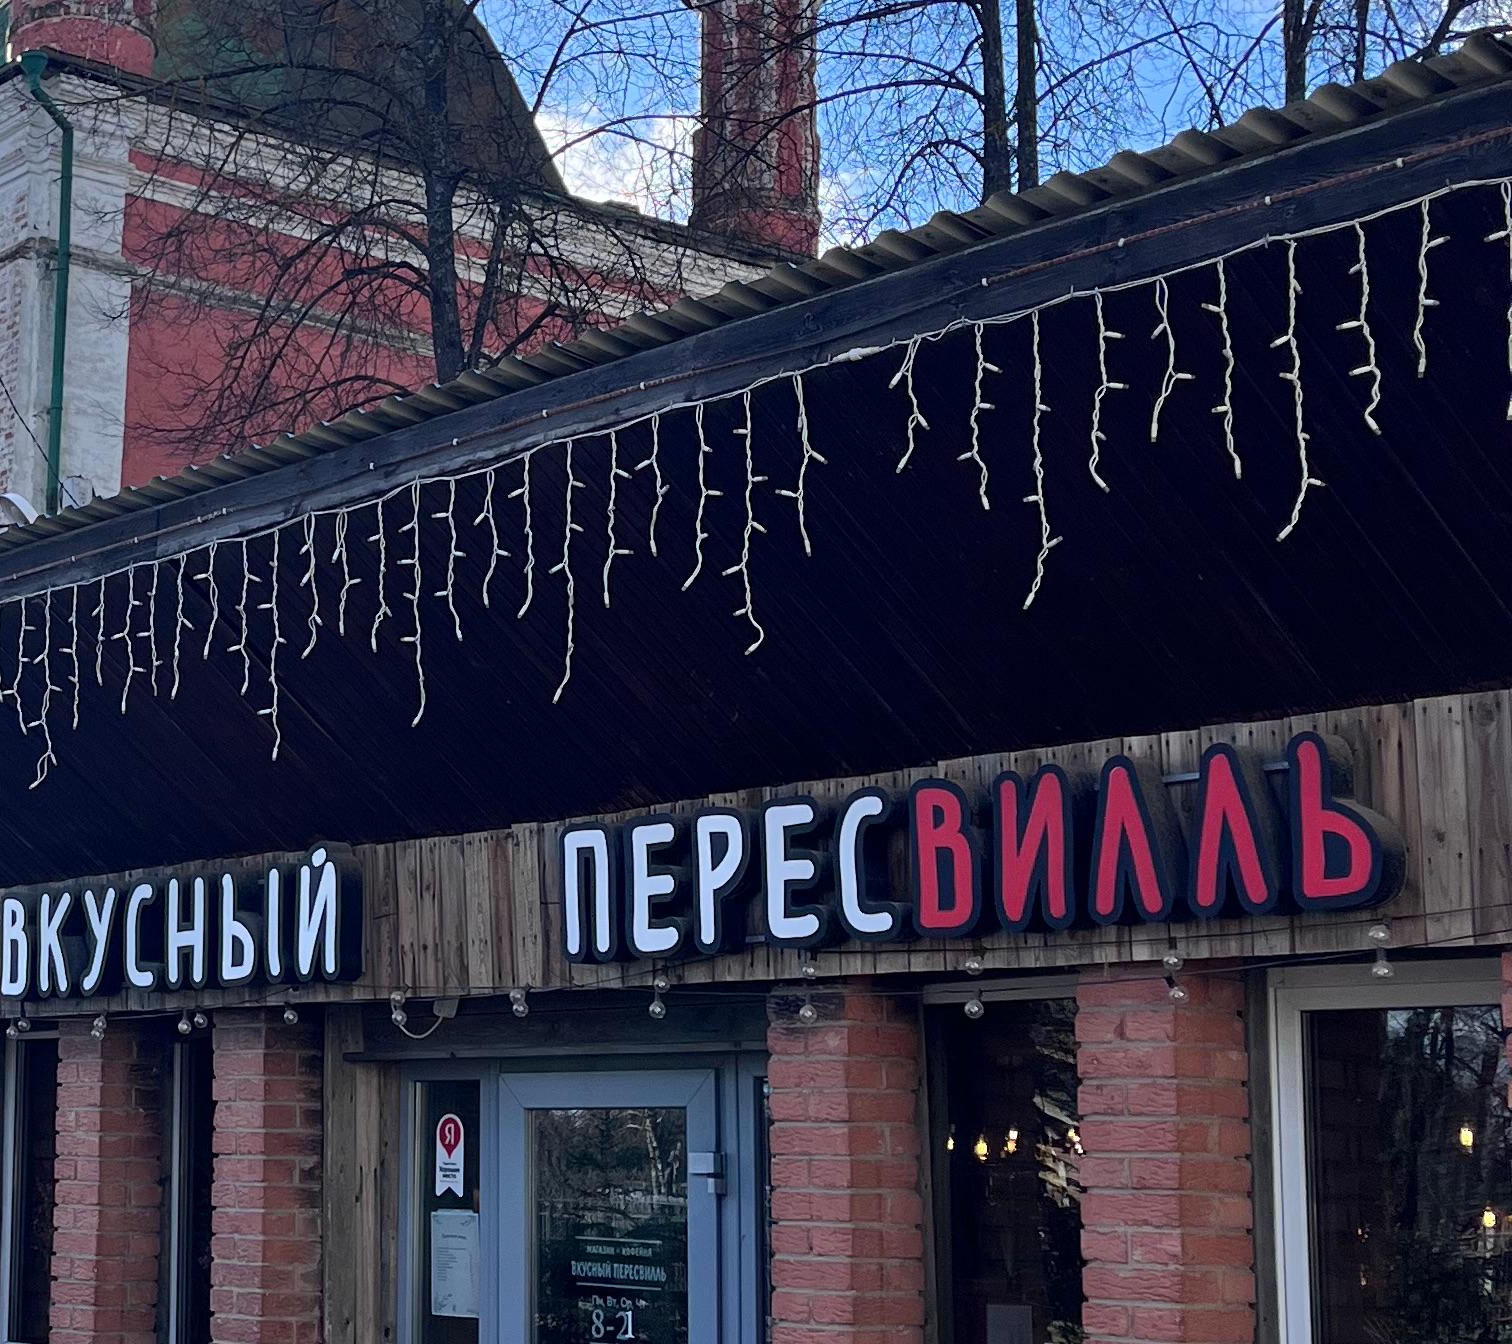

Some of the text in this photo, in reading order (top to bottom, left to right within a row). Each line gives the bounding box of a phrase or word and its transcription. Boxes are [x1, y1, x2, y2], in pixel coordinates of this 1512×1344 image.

[1, 741, 1373, 996] ВКУСНЫЙ ПЕРЕСВИЛЛЬ
[571, 1260, 667, 1282] ВКУСНЫЙ ПЕРЕСВИЛЛЬ
